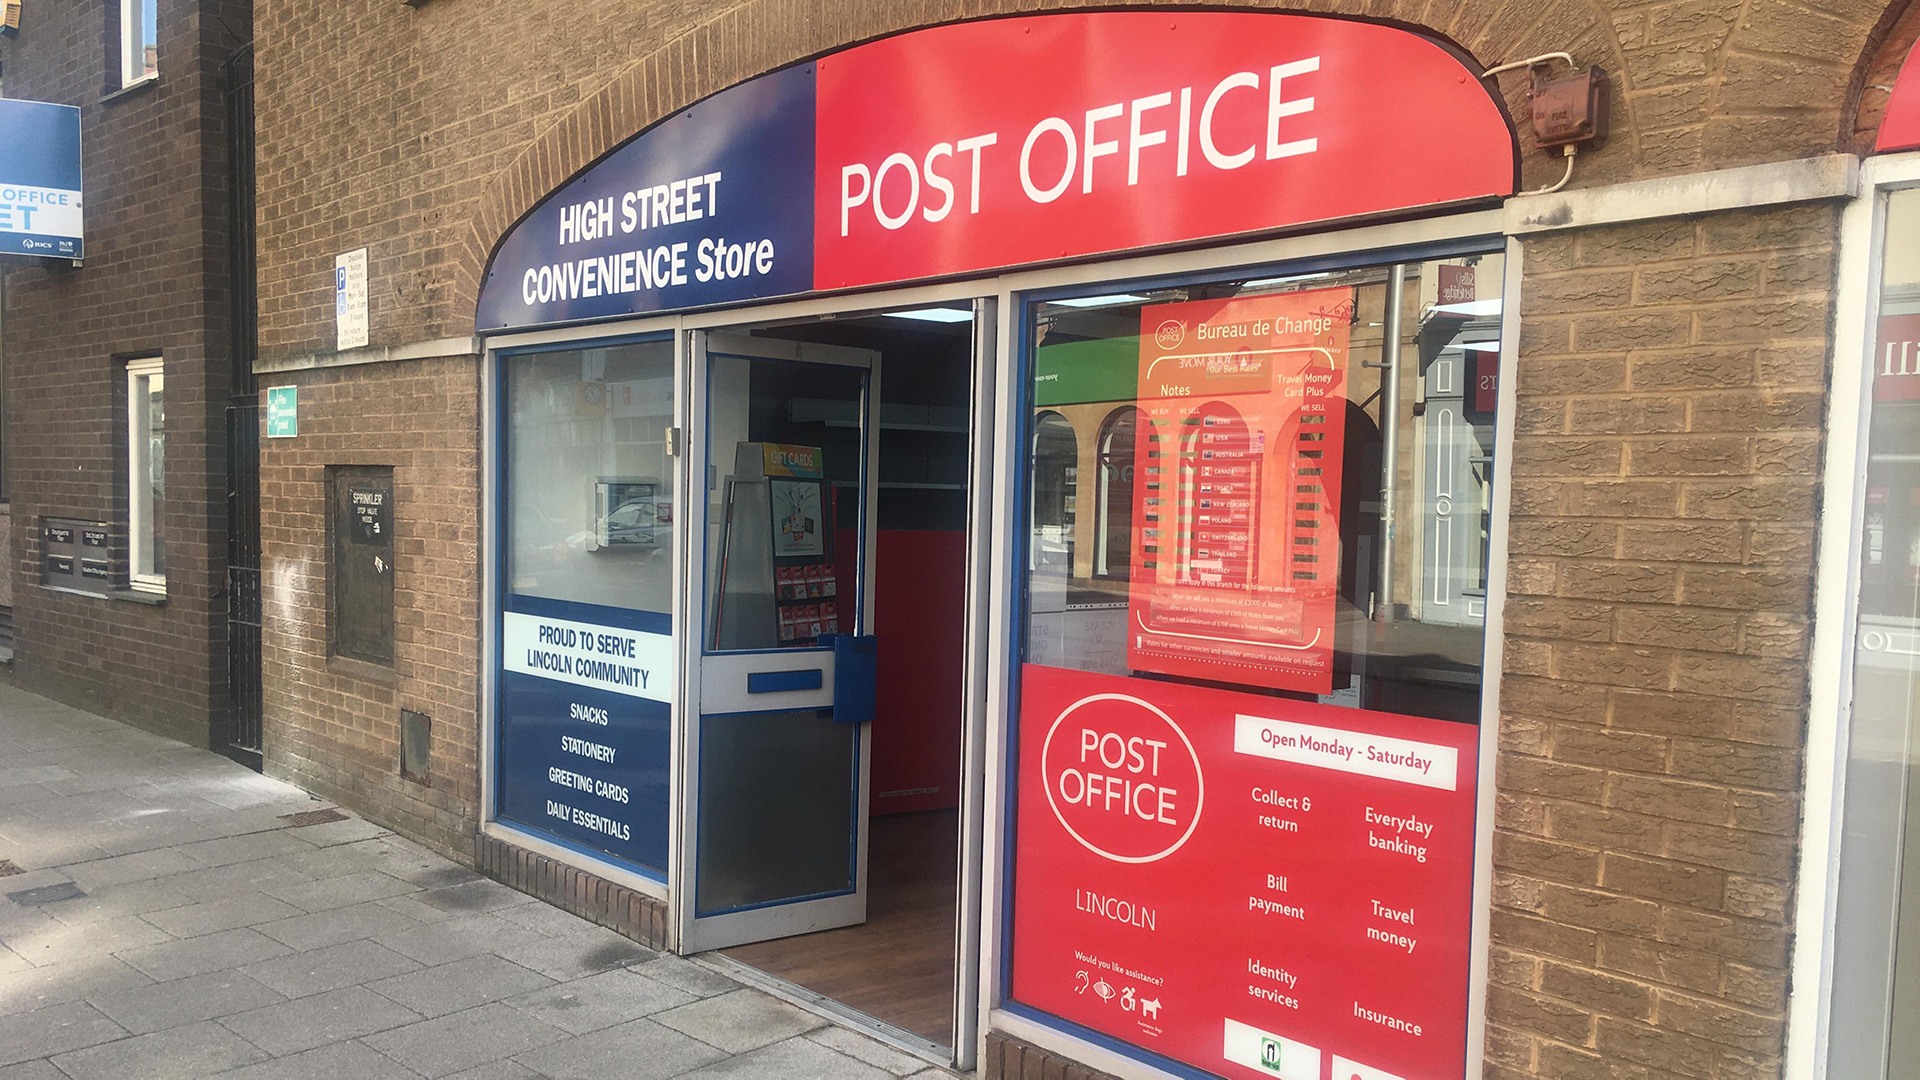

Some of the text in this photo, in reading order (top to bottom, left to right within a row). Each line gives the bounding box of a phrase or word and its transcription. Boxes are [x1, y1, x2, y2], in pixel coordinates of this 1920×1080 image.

[841, 55, 1320, 237] POST OFFICE
[3, 189, 68, 206] OFFICE
[559, 171, 721, 245] HIGH STREET
[348, 253, 364, 263] Disabled
[522, 238, 774, 305] CONVENIENCE Store
[1158, 334, 1180, 342] OFFICE
[1162, 326, 1178, 335] POST
[1197, 316, 1332, 340] Bureau de Change
[1160, 384, 1190, 396] Notes
[1277, 373, 1332, 385] Travel Money
[1284, 386, 1324, 397] Card Plus
[1188, 407, 1200, 415] SELL
[1311, 403, 1325, 411] SELL
[771, 450, 813, 467] GIFT CARDS
[353, 492, 382, 506] SPRINKLER
[357, 506, 378, 515] STOP VALVE
[539, 624, 636, 659] PROUD TO SERVE
[1161, 640, 1169, 648] for
[1169, 641, 1182, 649] other
[1183, 643, 1210, 653] currencies
[1221, 648, 1242, 656] smaller
[1242, 651, 1267, 660] amounts
[1268, 653, 1293, 664] available
[1293, 657, 1301, 665] on
[1302, 657, 1325, 668] request
[527, 648, 649, 689] LINCOLN COMMUNITY
[570, 702, 608, 726] SNACKS
[561, 735, 616, 763] STATIONERY
[1081, 728, 1167, 776] POST
[1261, 728, 1296, 749] Open
[1300, 734, 1353, 761] Monday
[1367, 745, 1432, 774] Saturday
[549, 766, 629, 804] GREETING CARDS
[1060, 768, 1177, 826] OFFICE
[1251, 787, 1311, 812] Collect &
[547, 800, 630, 841] DAILY ESSENTIALS
[1259, 814, 1298, 832] return
[1365, 807, 1433, 839] Everyday
[1369, 831, 1427, 863] banking
[1267, 873, 1287, 892] Bill
[1076, 888, 1155, 931] LINCOLN
[1249, 896, 1305, 920] payment
[1371, 899, 1415, 925] Travel
[1367, 927, 1417, 954] money
[1075, 950, 1164, 987] Would you like assistance?
[1248, 958, 1297, 989] Identity
[1248, 984, 1299, 1009] services
[1354, 1001, 1422, 1036] Insurance
